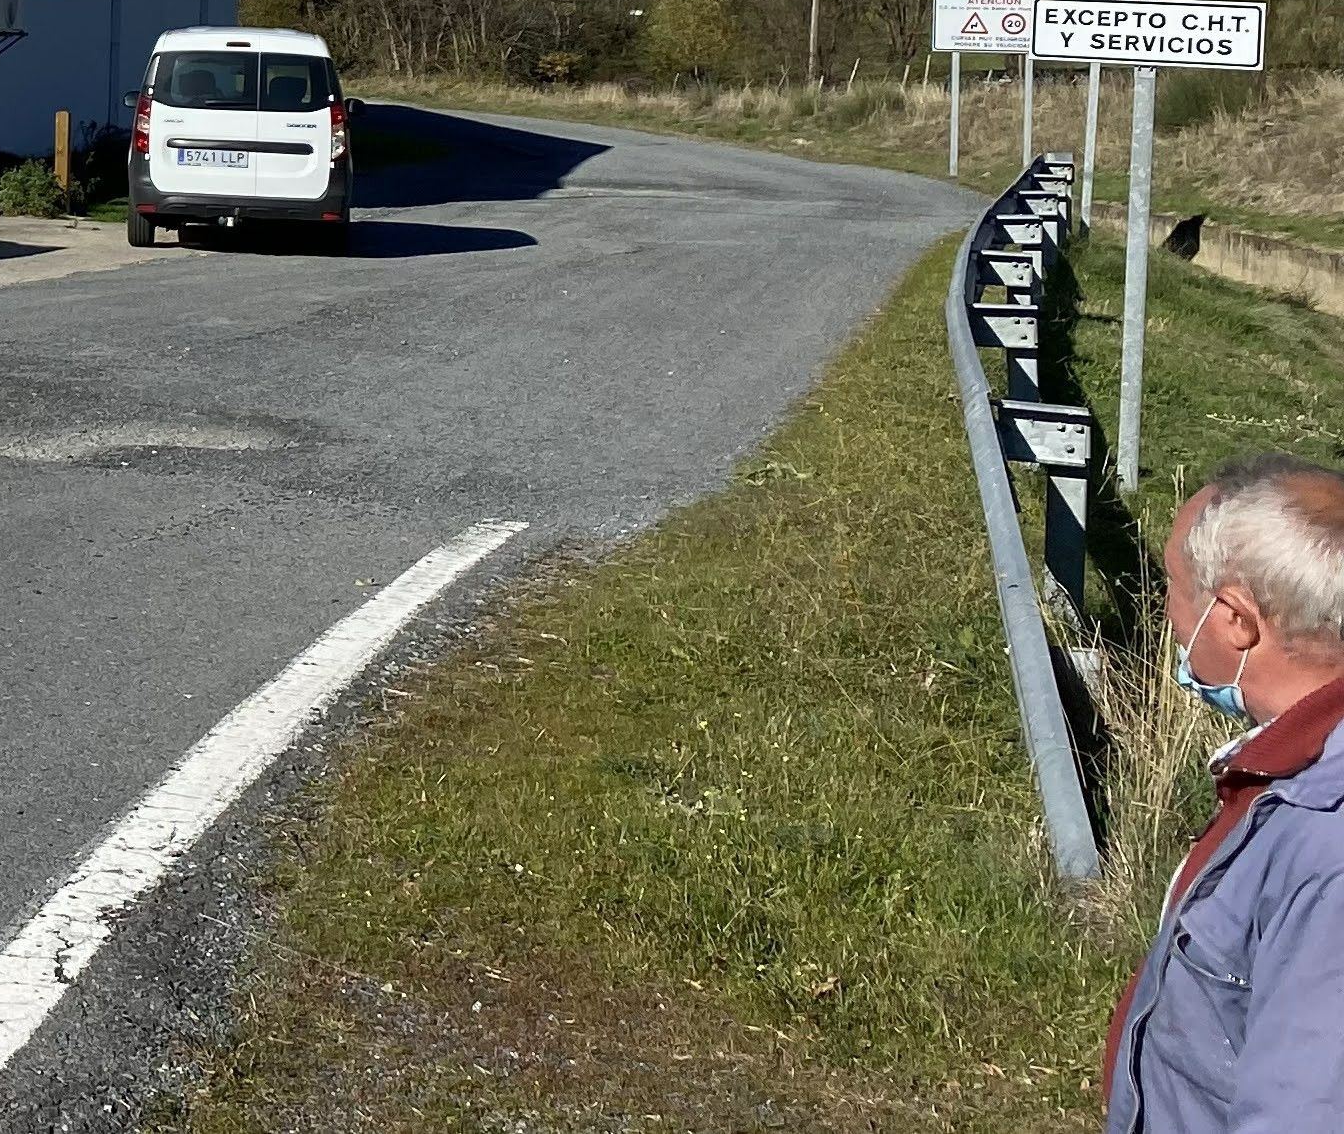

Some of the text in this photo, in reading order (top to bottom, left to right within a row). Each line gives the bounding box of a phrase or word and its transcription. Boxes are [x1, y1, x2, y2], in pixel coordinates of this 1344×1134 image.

[1007, 20, 1021, 28] 20
[1045, 8, 1250, 33] EXCEPTO C.H.T.
[1060, 31, 1233, 56] Y SERVICIOS
[186, 151, 245, 164] 5741 LLP
